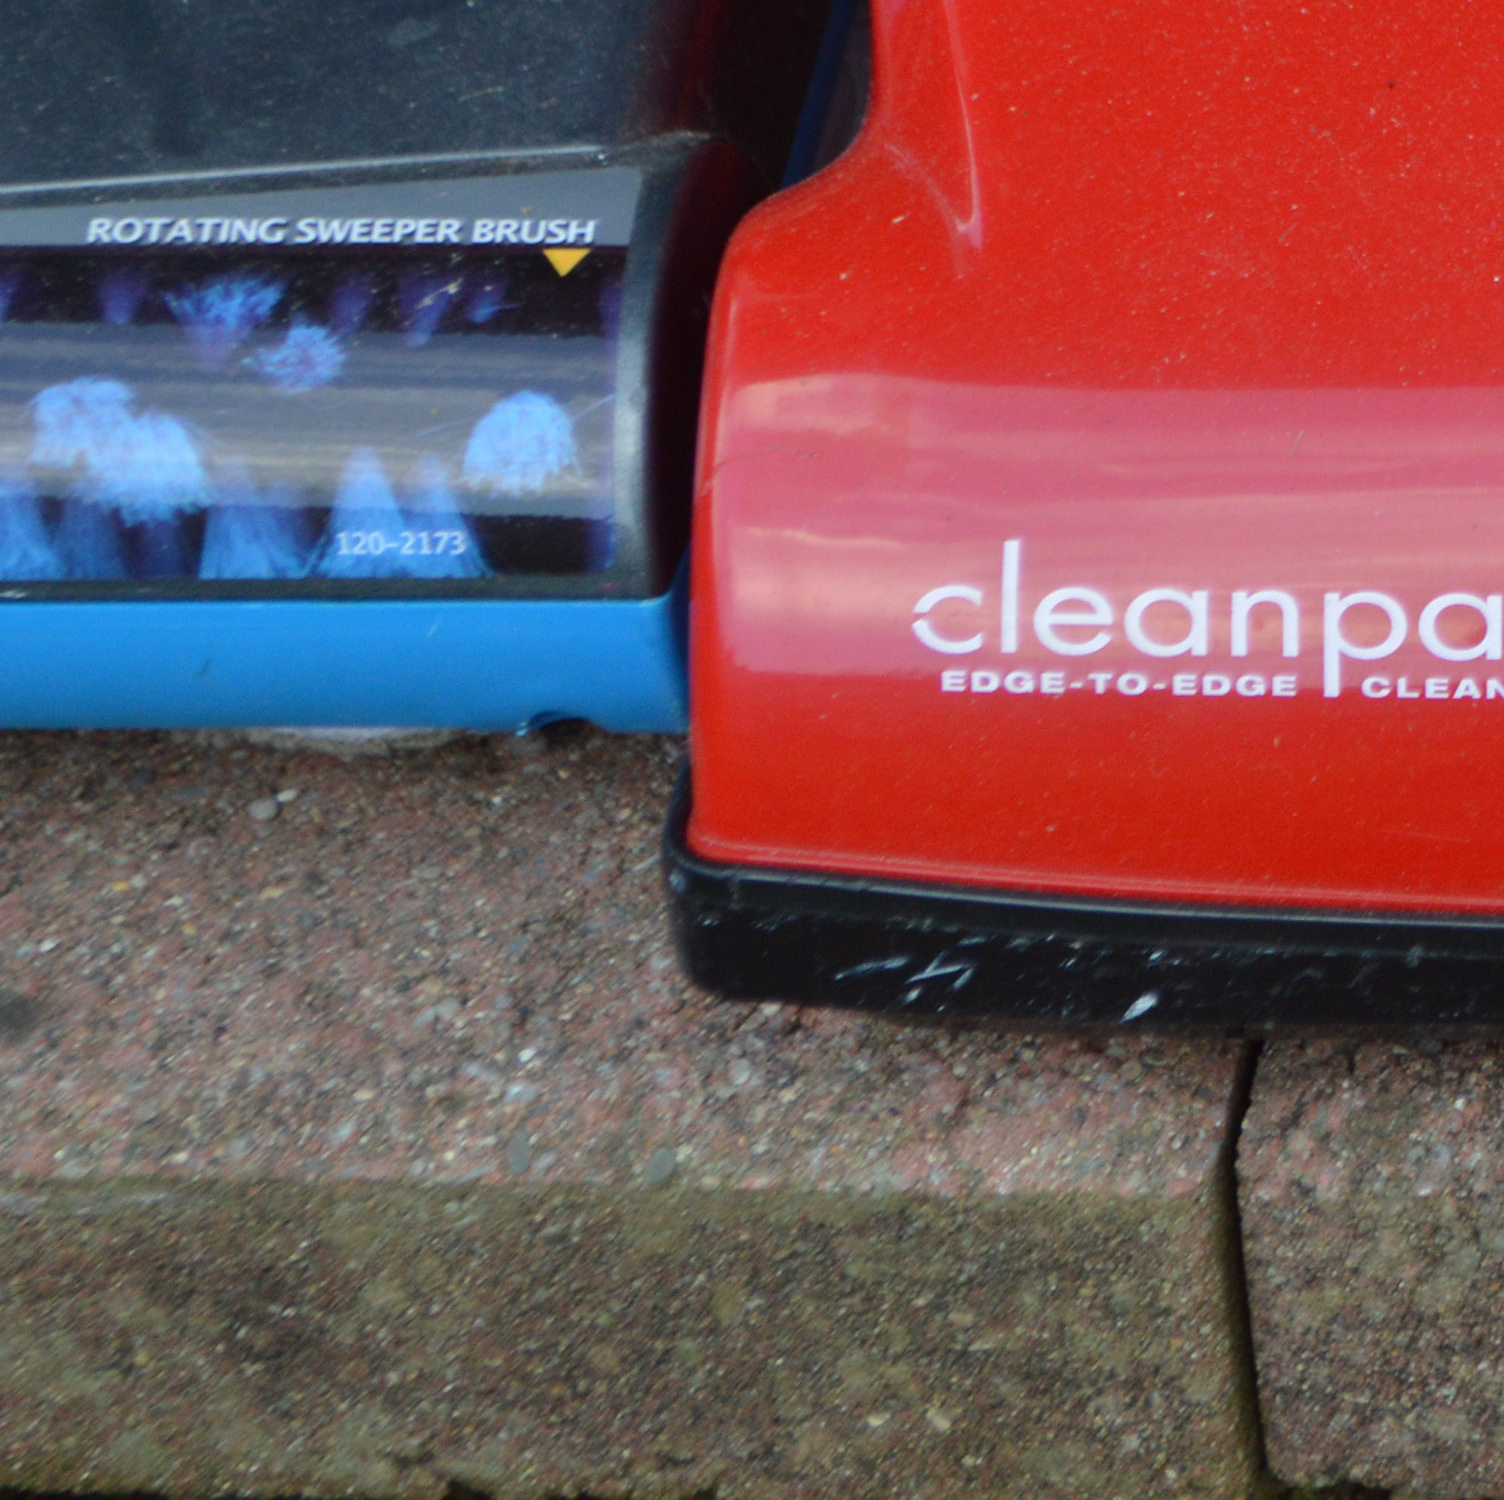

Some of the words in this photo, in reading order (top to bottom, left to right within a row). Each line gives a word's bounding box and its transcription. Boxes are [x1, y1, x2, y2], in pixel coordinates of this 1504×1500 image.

[86, 216, 286, 246] ROTATING
[293, 217, 461, 246] SWEEPER
[471, 217, 597, 245] BRUSH
[336, 531, 467, 556] 120-2173
[940, 670, 1297, 698] EDGE-TO-EDGE
